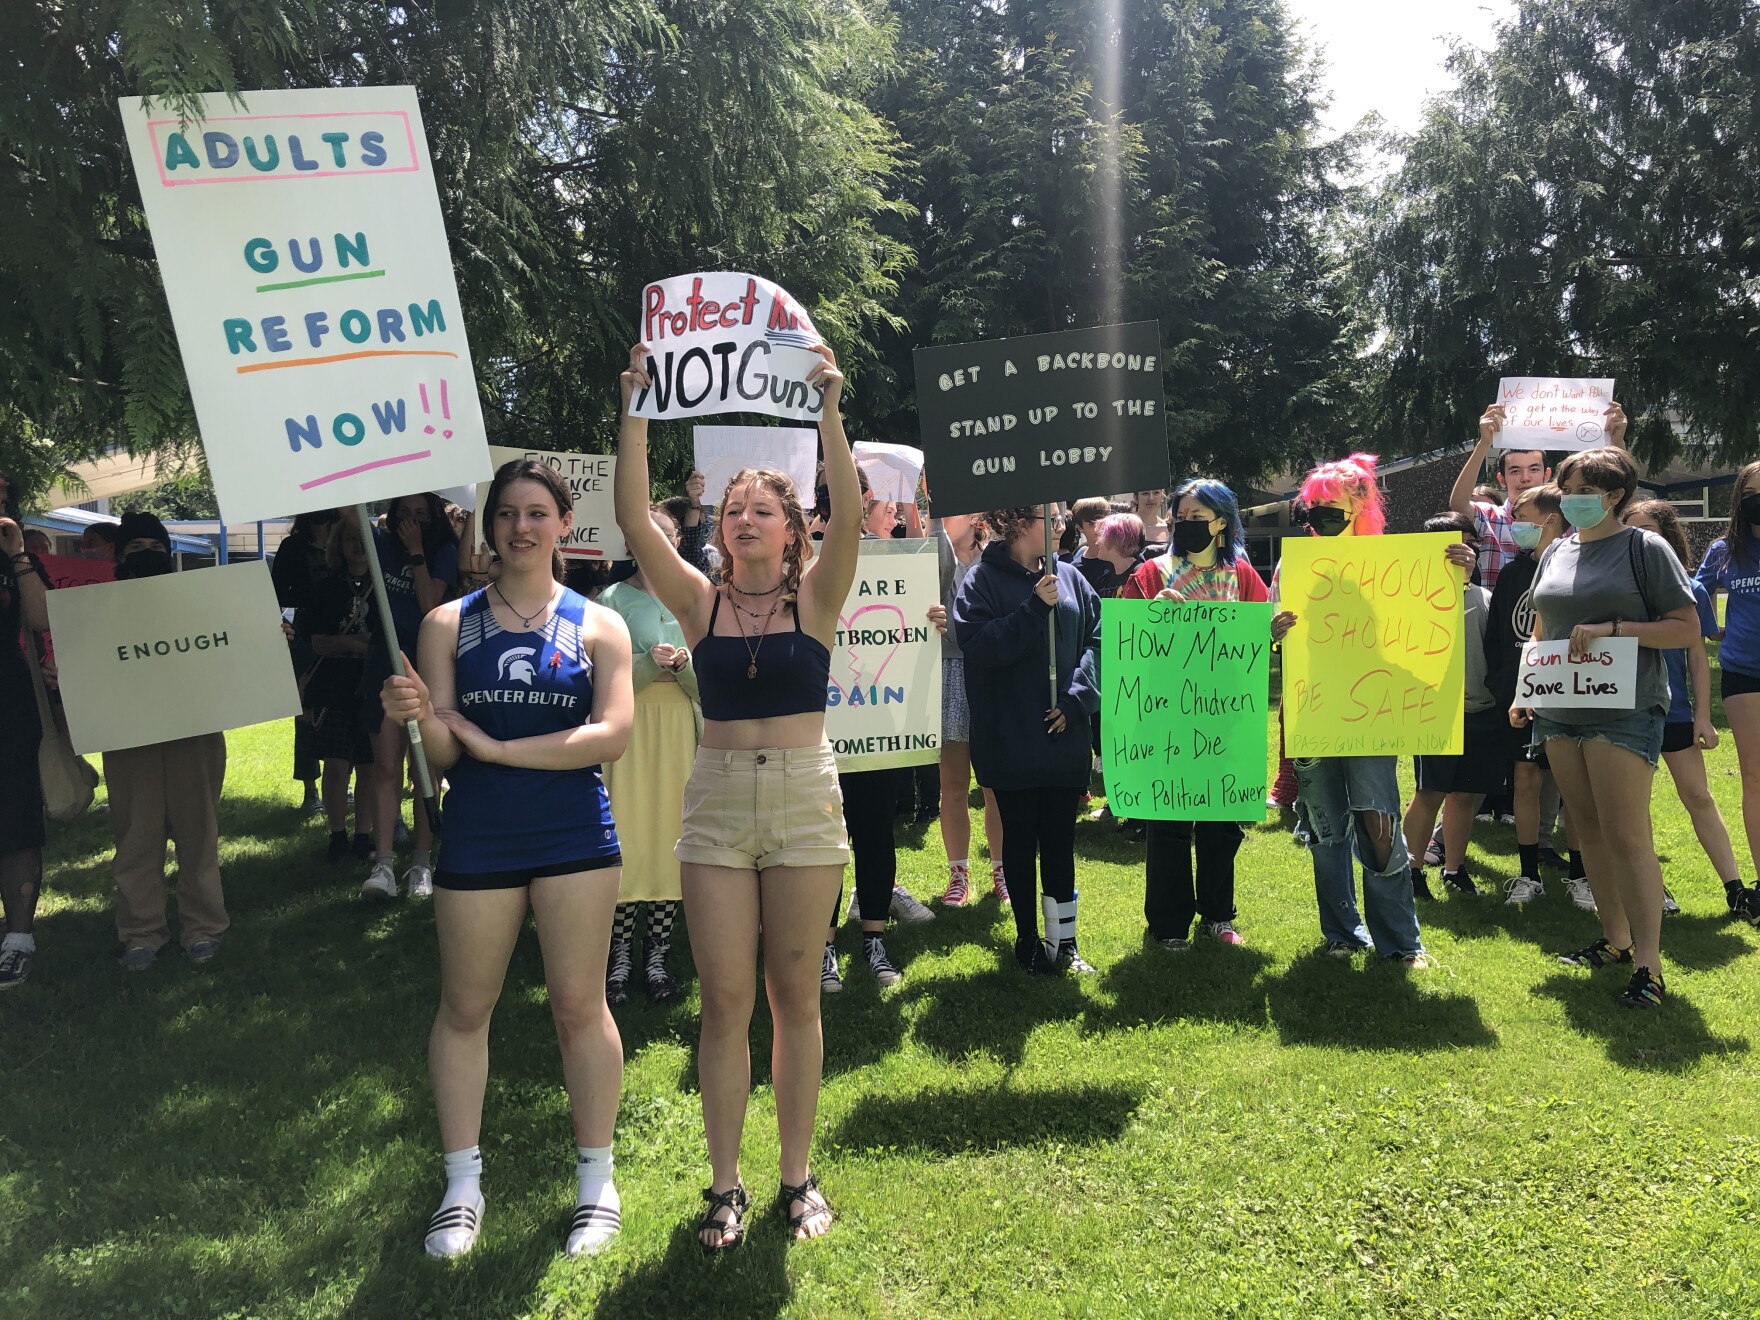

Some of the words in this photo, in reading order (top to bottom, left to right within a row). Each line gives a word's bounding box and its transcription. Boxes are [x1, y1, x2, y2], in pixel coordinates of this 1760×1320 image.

[165, 131, 388, 172] ADULTS
[244, 231, 371, 274] GUN
[645, 277, 760, 342] Protect
[223, 299, 447, 355] REFORM
[635, 341, 738, 413] NOT
[736, 339, 824, 414] Guns
[938, 365, 981, 391] GET
[1004, 359, 1018, 377] A
[1036, 351, 1157, 372] BACKBONE
[1502, 381, 1525, 400] We
[949, 413, 1018, 438] STAND
[1028, 405, 1058, 425] UP
[1072, 401, 1098, 418] TO
[1112, 399, 1156, 417] THE
[1523, 418, 1544, 427] our
[1526, 403, 1547, 418] get
[1549, 405, 1558, 413] in
[1561, 404, 1577, 413] the
[567, 458, 609, 477] THE
[971, 455, 1016, 476] GUN
[1039, 446, 1113, 467] LOBBY
[563, 476, 603, 492] NCE
[858, 579, 907, 597] ARE
[1306, 554, 1458, 612] SCHOOLS
[1147, 600, 1237, 624] Senators:
[117, 630, 229, 662] ENOUGH
[834, 626, 928, 647] TBROKEN
[1118, 621, 1175, 661] HOW
[1309, 612, 1452, 656] SHOULD
[1525, 646, 1562, 667] Gun
[461, 689, 525, 707] SPENCER
[527, 690, 578, 708] BUTTE
[826, 684, 904, 707] GAIN
[1114, 675, 1169, 722] More
[1294, 678, 1325, 715] BE
[1341, 669, 1439, 728] SAFE
[1521, 672, 1565, 698] Save
[1573, 671, 1619, 695] Lives
[1113, 733, 1155, 768] Have
[1163, 730, 1181, 765] to
[1192, 728, 1227, 760] Die
[1293, 734, 1330, 753] PASS
[1333, 734, 1365, 753] GUN
[1372, 736, 1406, 752] LAWS
[1417, 733, 1453, 751] NOW
[1113, 781, 1142, 810] For
[1151, 776, 1211, 812] Political
[1220, 773, 1266, 808] Power
